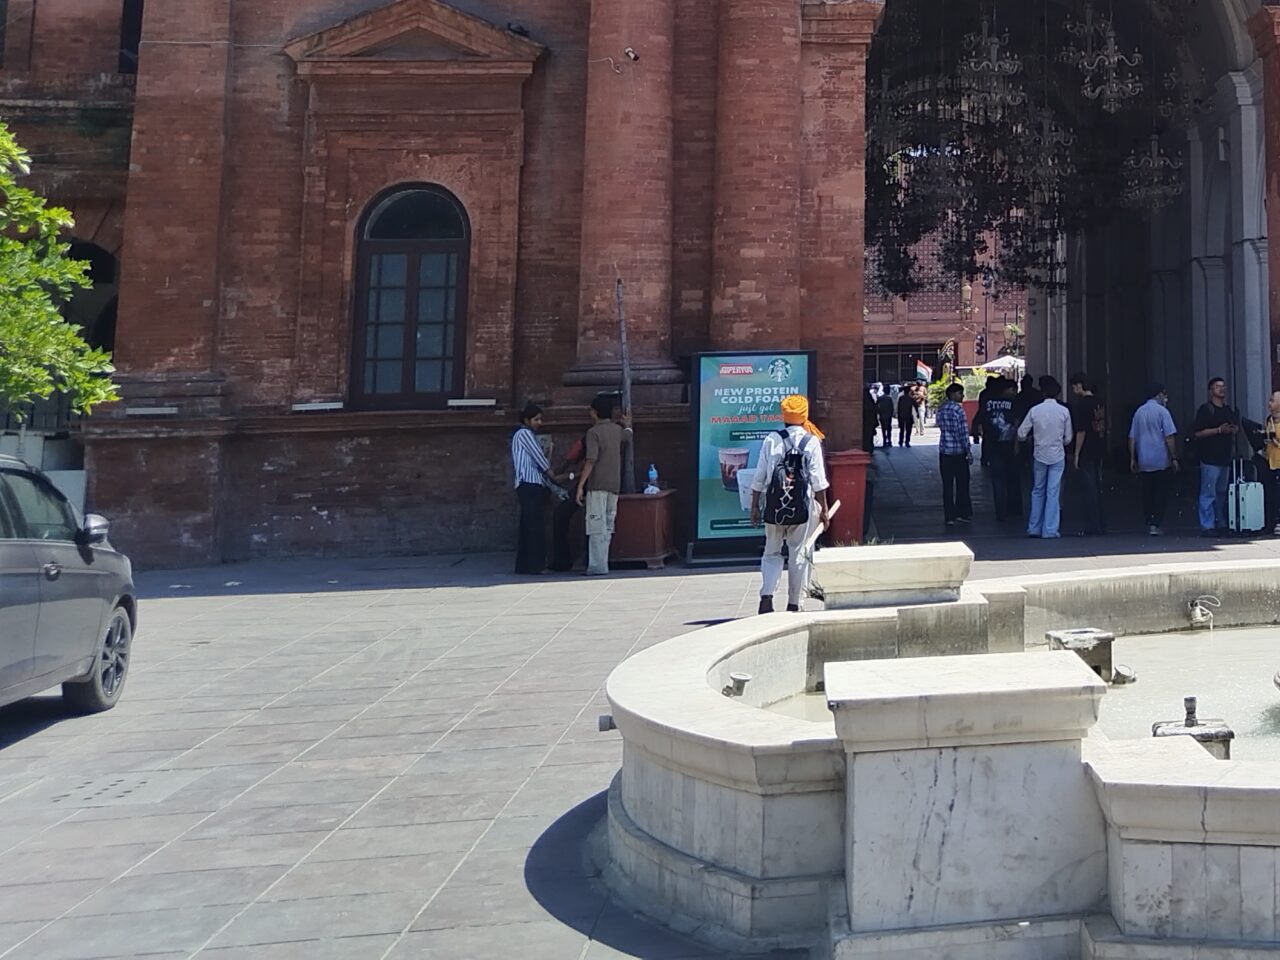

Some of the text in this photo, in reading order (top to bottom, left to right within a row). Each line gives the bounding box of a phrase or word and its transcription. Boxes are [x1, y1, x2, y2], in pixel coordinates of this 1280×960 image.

[714, 386, 799, 396] NEW PROTEIN
[721, 395, 753, 404] COLD
